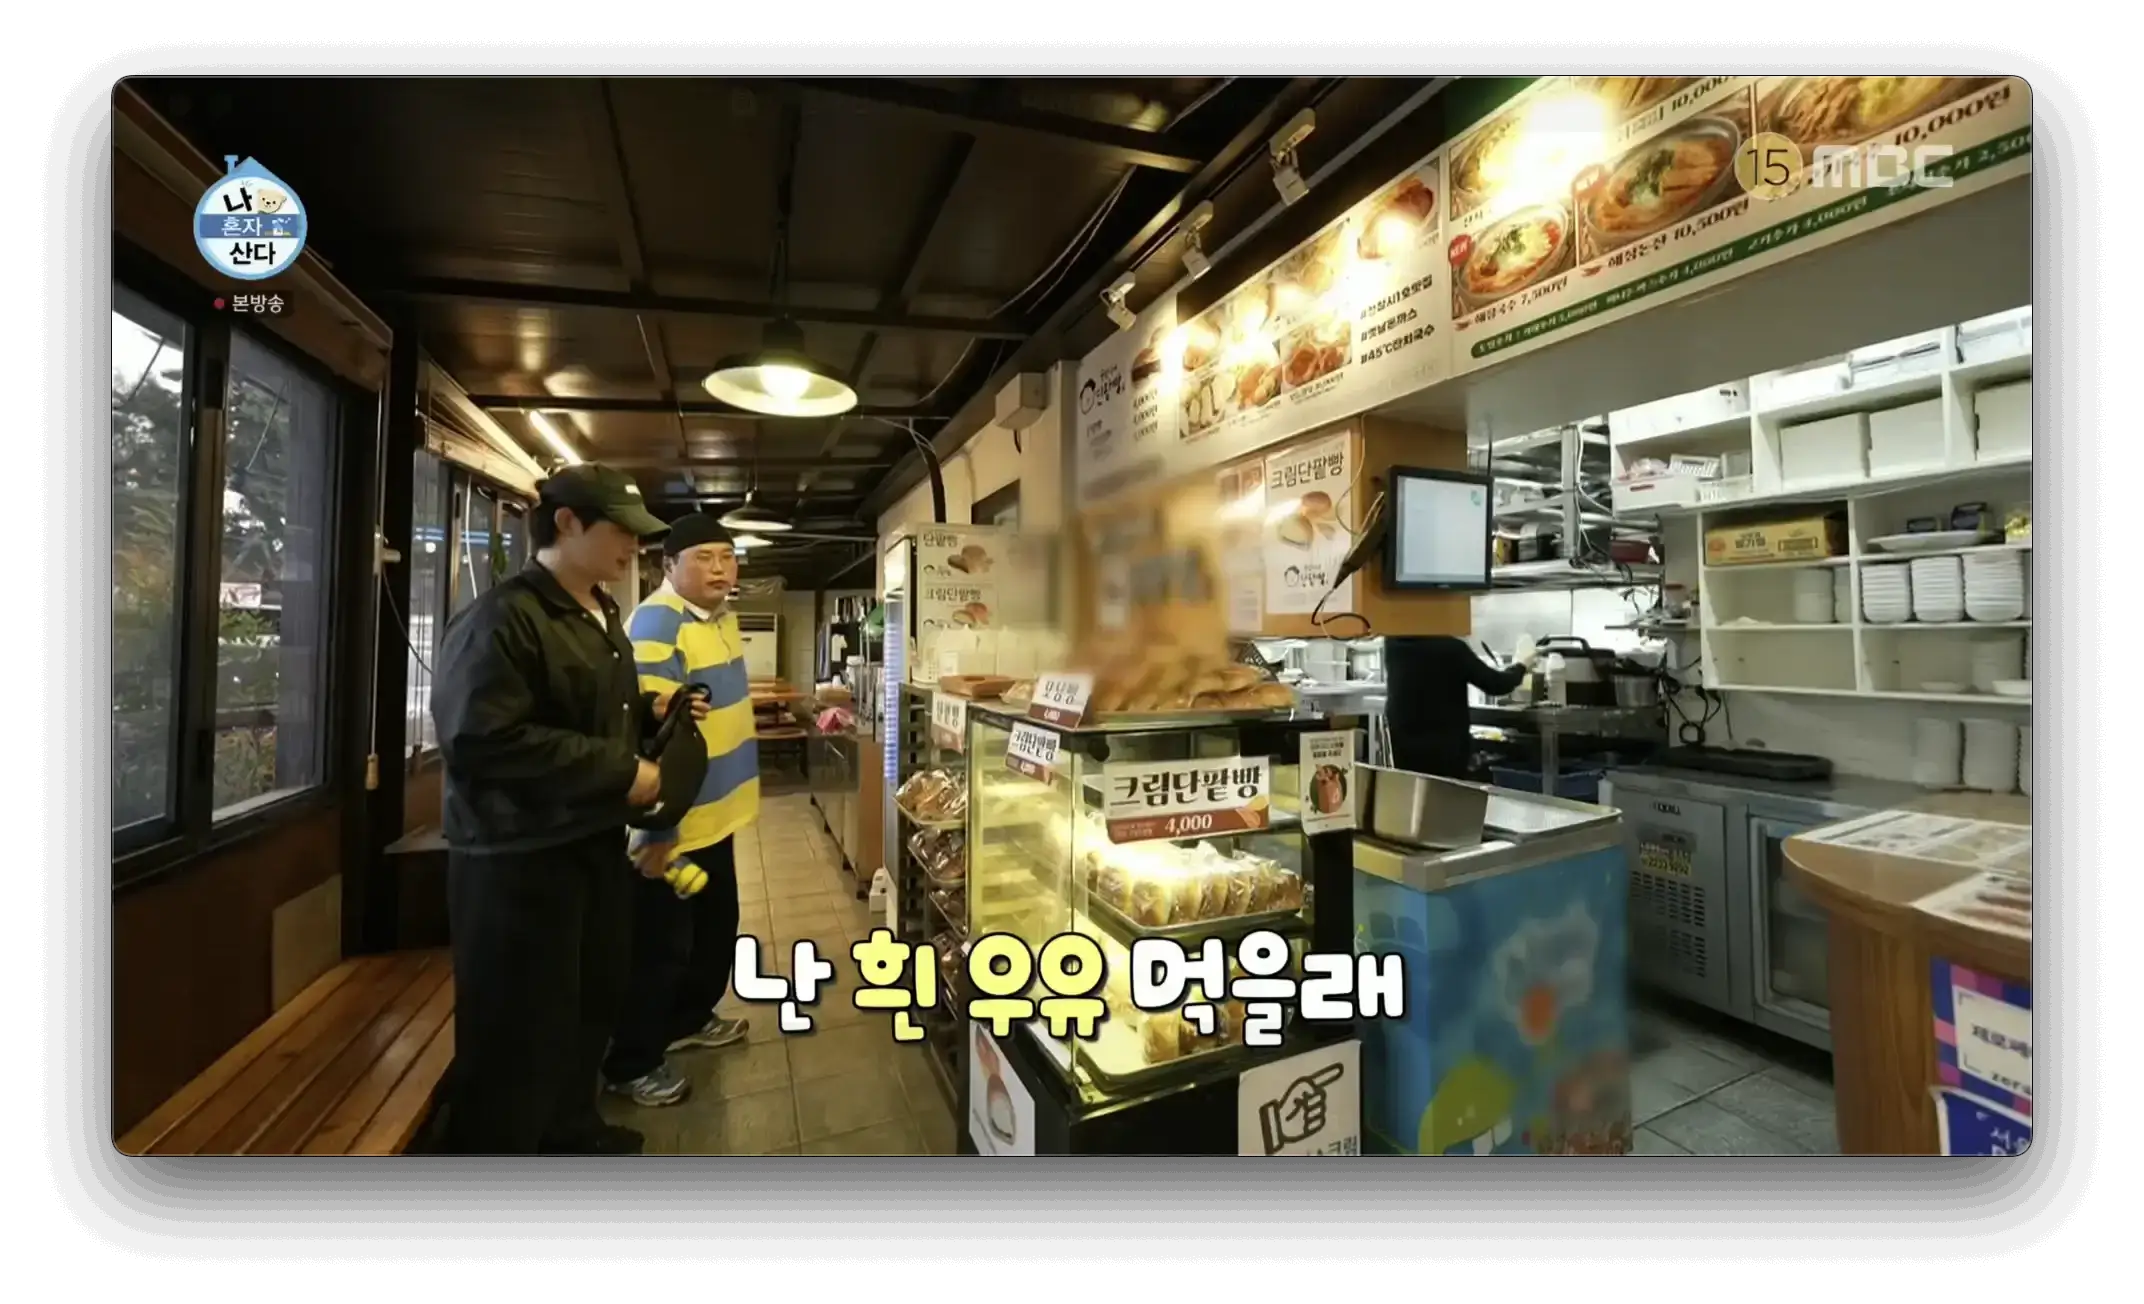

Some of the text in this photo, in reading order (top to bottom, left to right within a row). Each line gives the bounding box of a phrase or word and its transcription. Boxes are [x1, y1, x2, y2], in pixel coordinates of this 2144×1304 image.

[1271, 450, 1344, 490] 크림단팥빵
[924, 587, 981, 602] 크림단팥빵
[1014, 729, 1057, 762] 크림단팥빵
[1109, 764, 1263, 807] 크림단팥빵
[1164, 813, 1213, 836] 4,000
